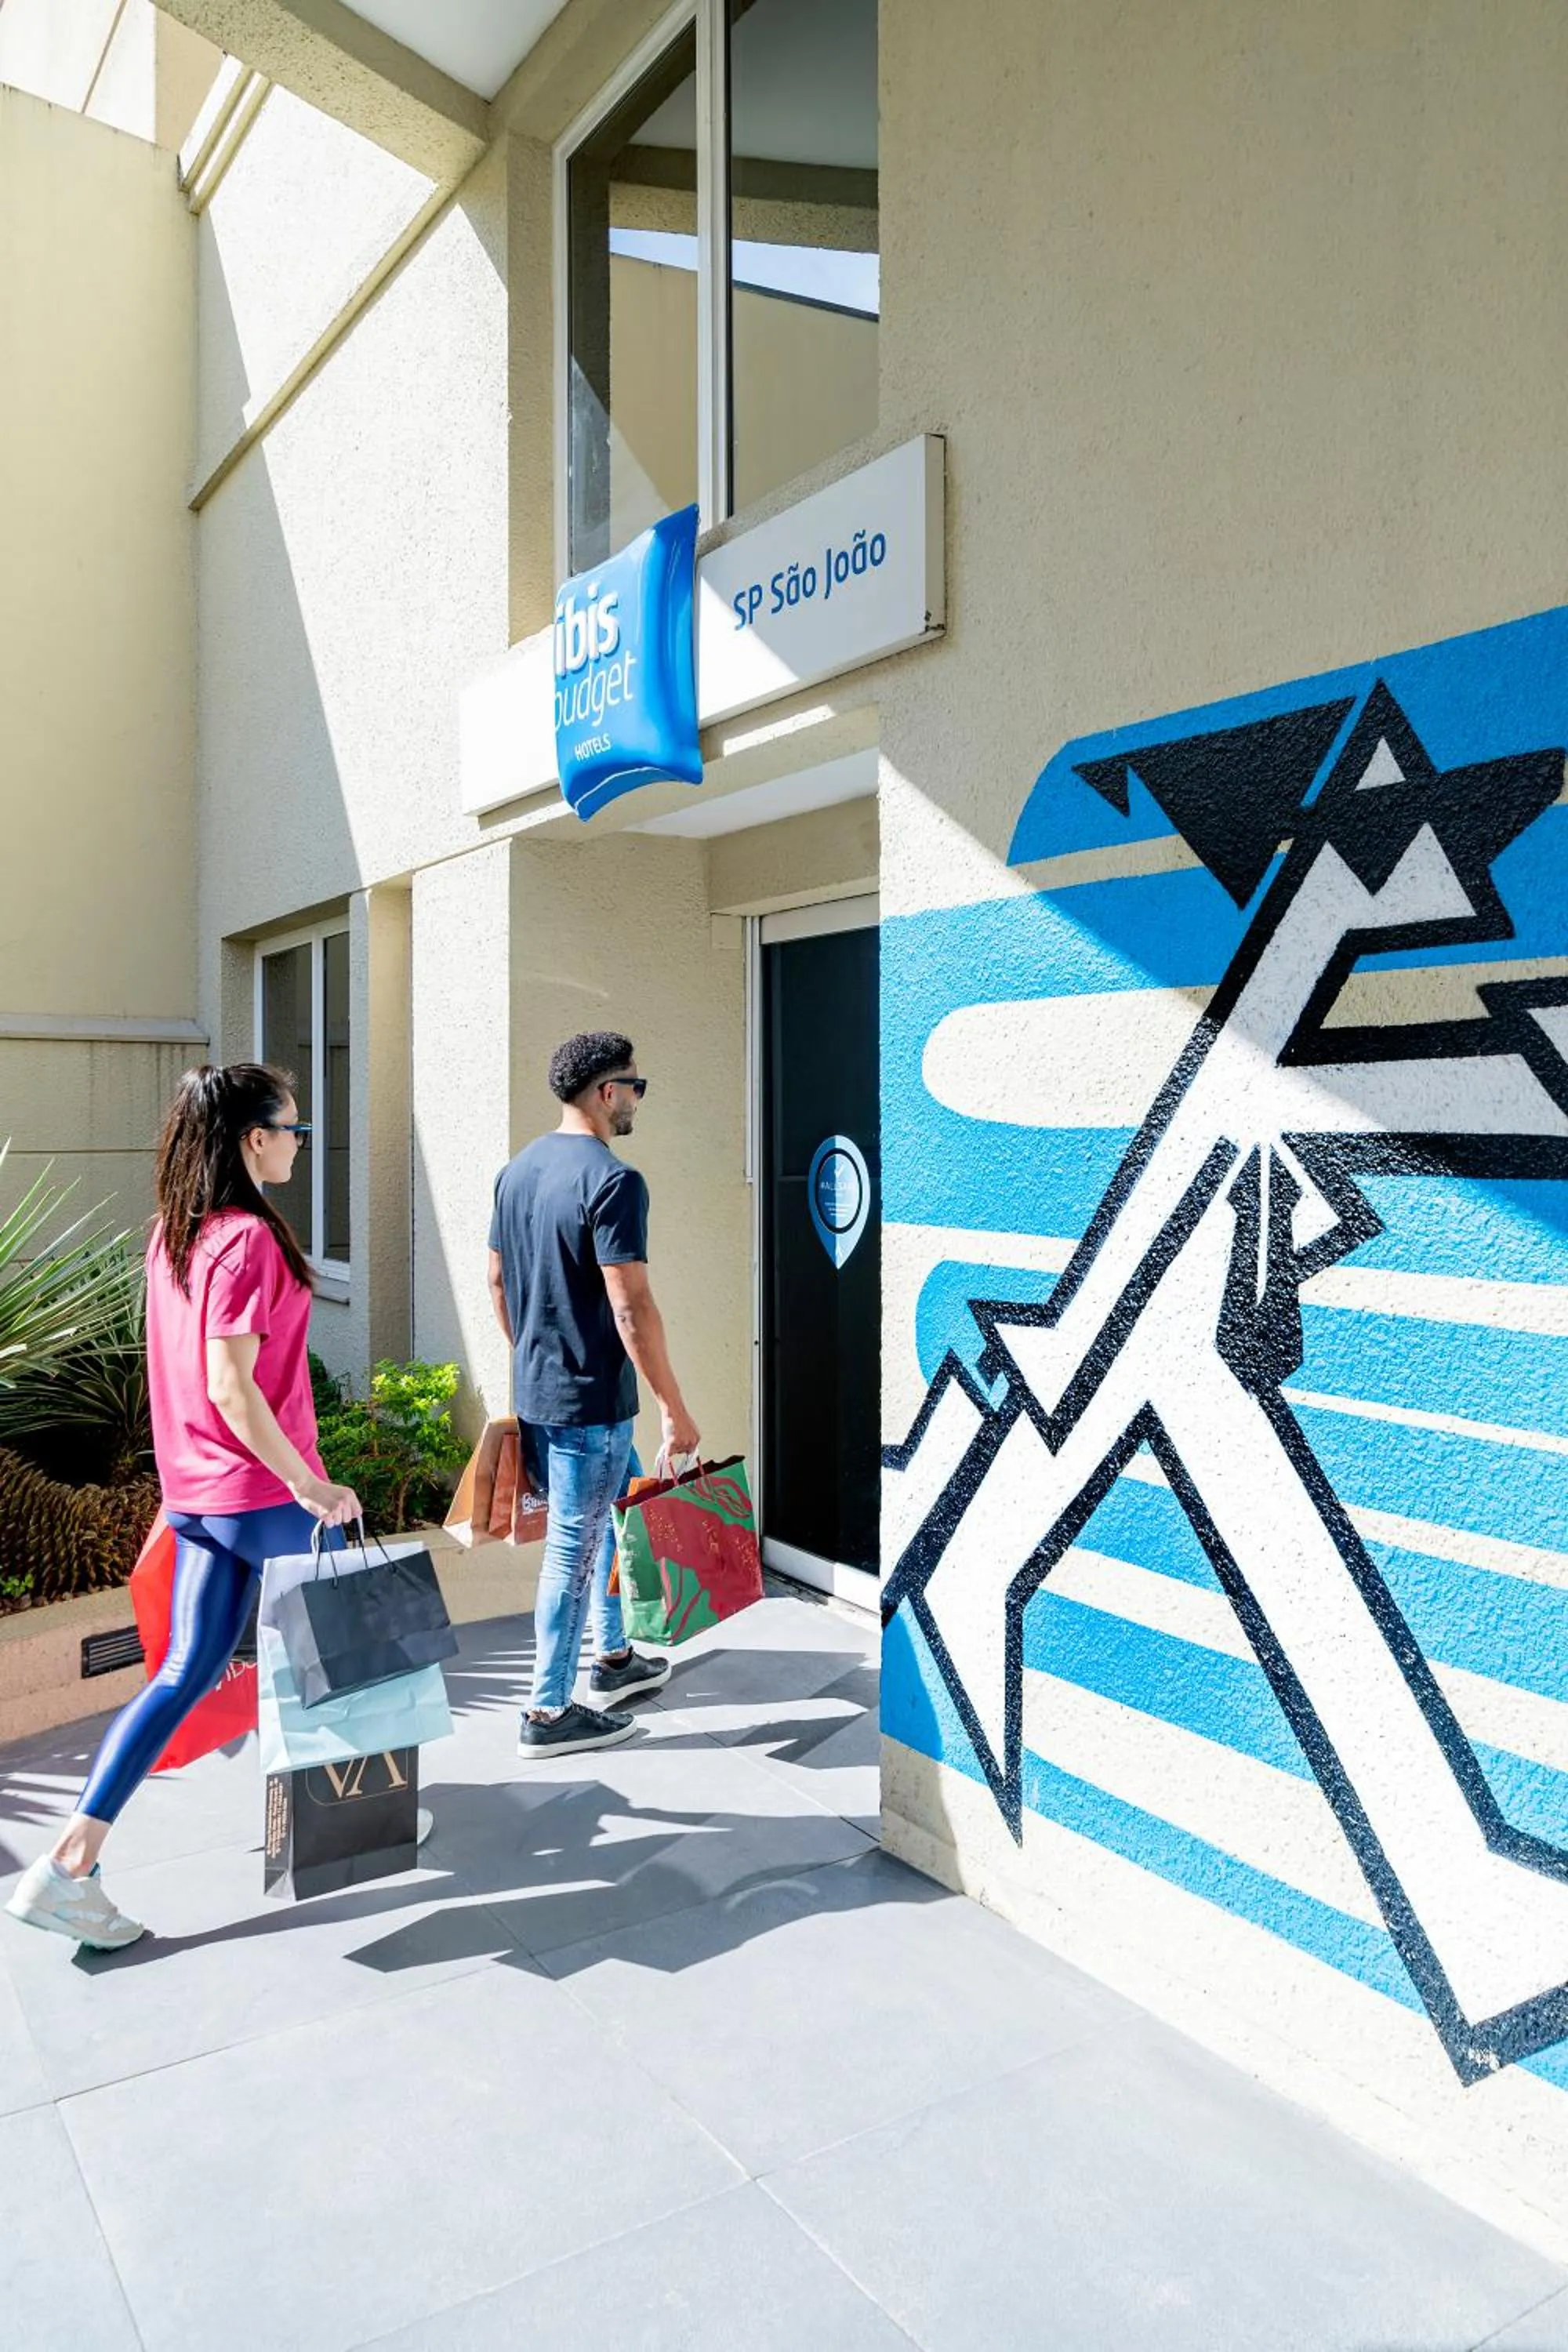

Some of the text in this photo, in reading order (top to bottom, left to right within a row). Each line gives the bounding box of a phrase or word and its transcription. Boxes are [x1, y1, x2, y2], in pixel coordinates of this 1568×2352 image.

[733, 529, 886, 630] SP São João
[554, 582, 620, 678] ibis
[574, 733, 612, 763] HOTELS
